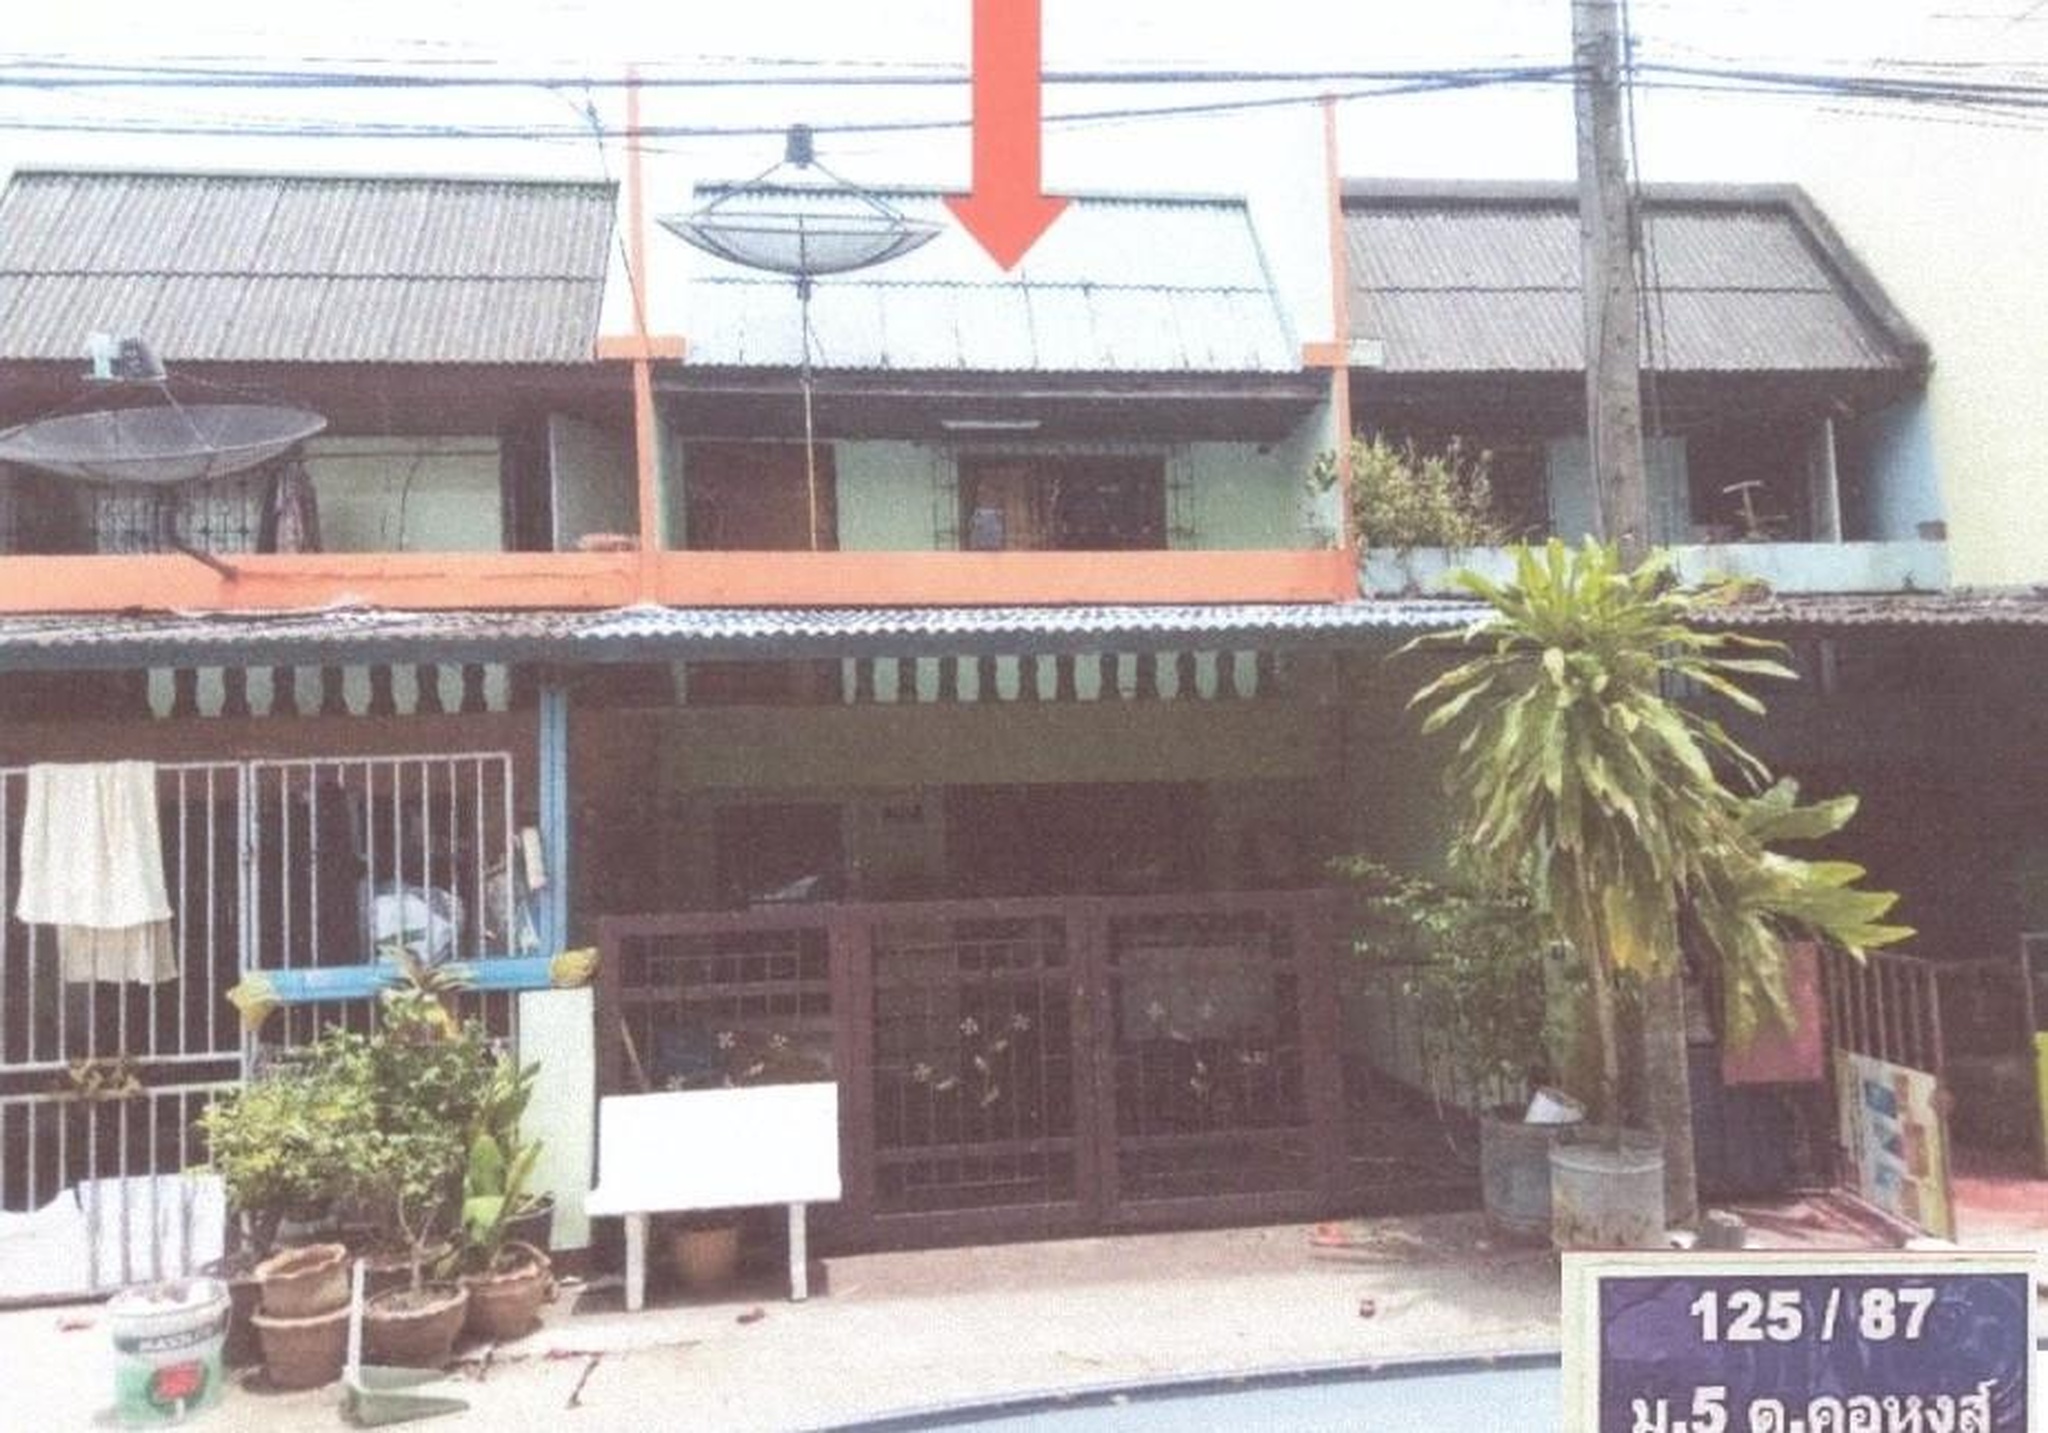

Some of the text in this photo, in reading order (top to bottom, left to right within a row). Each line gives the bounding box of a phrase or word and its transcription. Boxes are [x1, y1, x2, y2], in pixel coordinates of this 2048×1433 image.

[1691, 1288, 1935, 1341] 125 / 87
